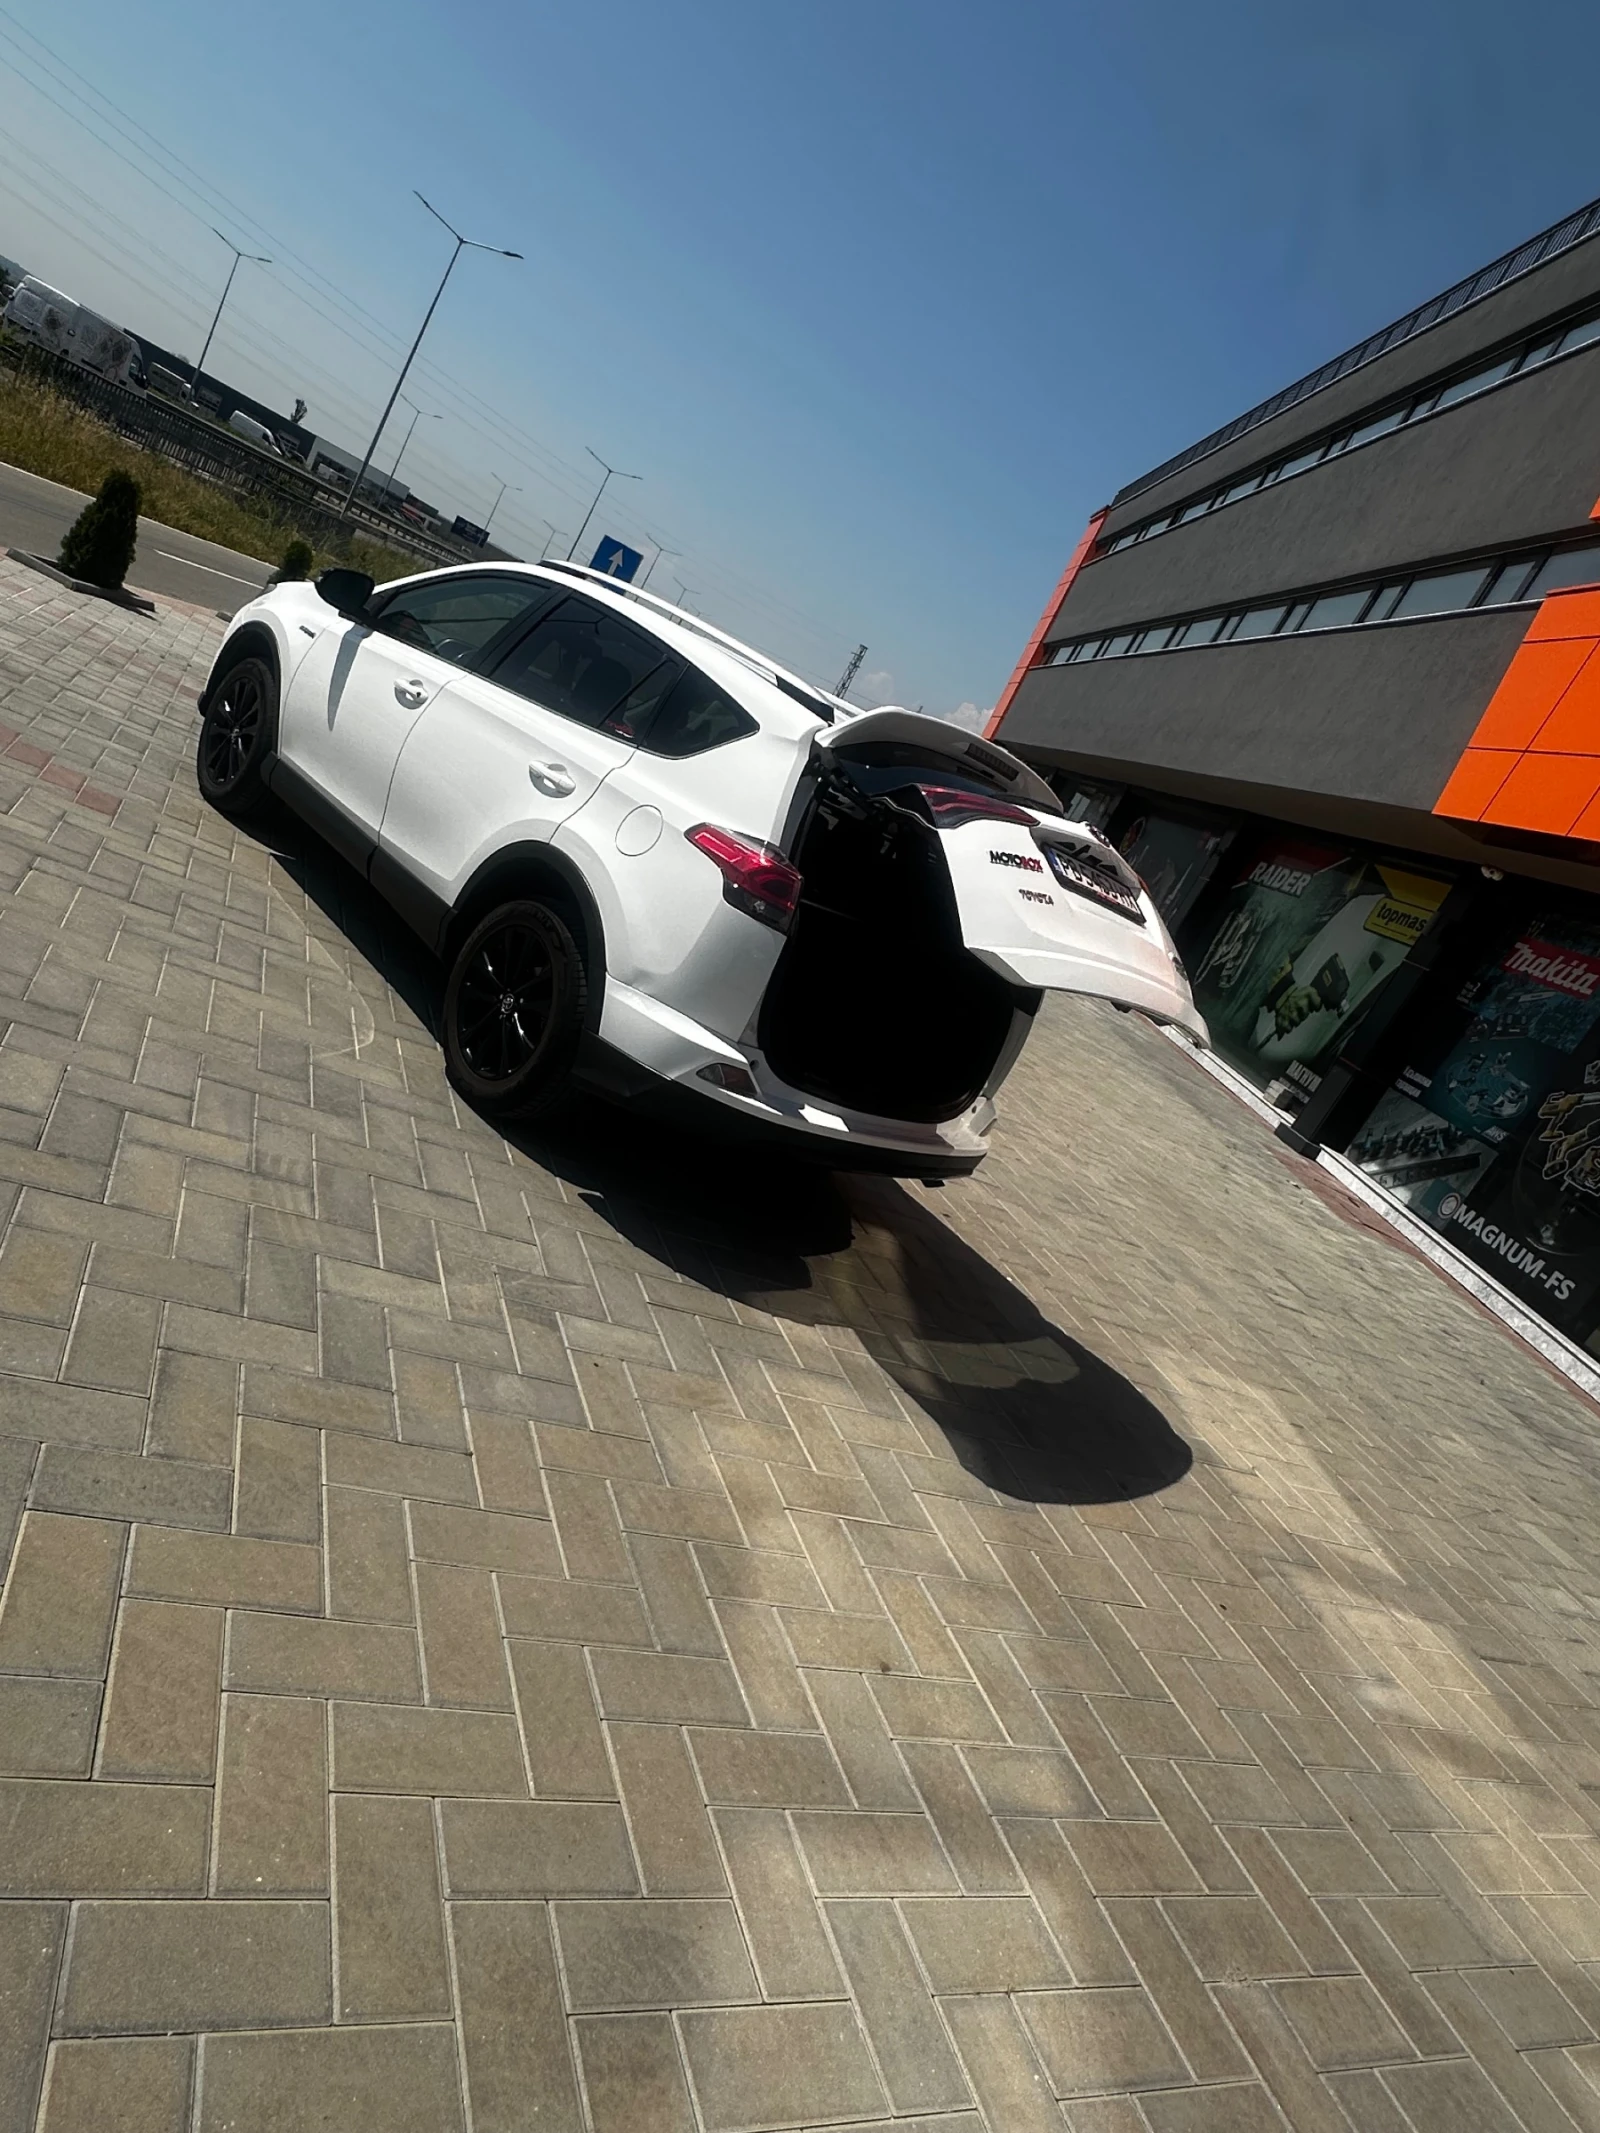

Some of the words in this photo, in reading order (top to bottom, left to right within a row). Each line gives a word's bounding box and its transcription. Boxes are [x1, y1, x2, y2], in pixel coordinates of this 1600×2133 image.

[1248, 861, 1312, 896] RAIDER
[1018, 888, 1055, 907] TOYOTA
[1452, 1199, 1577, 1301] MAGNUM-FS
